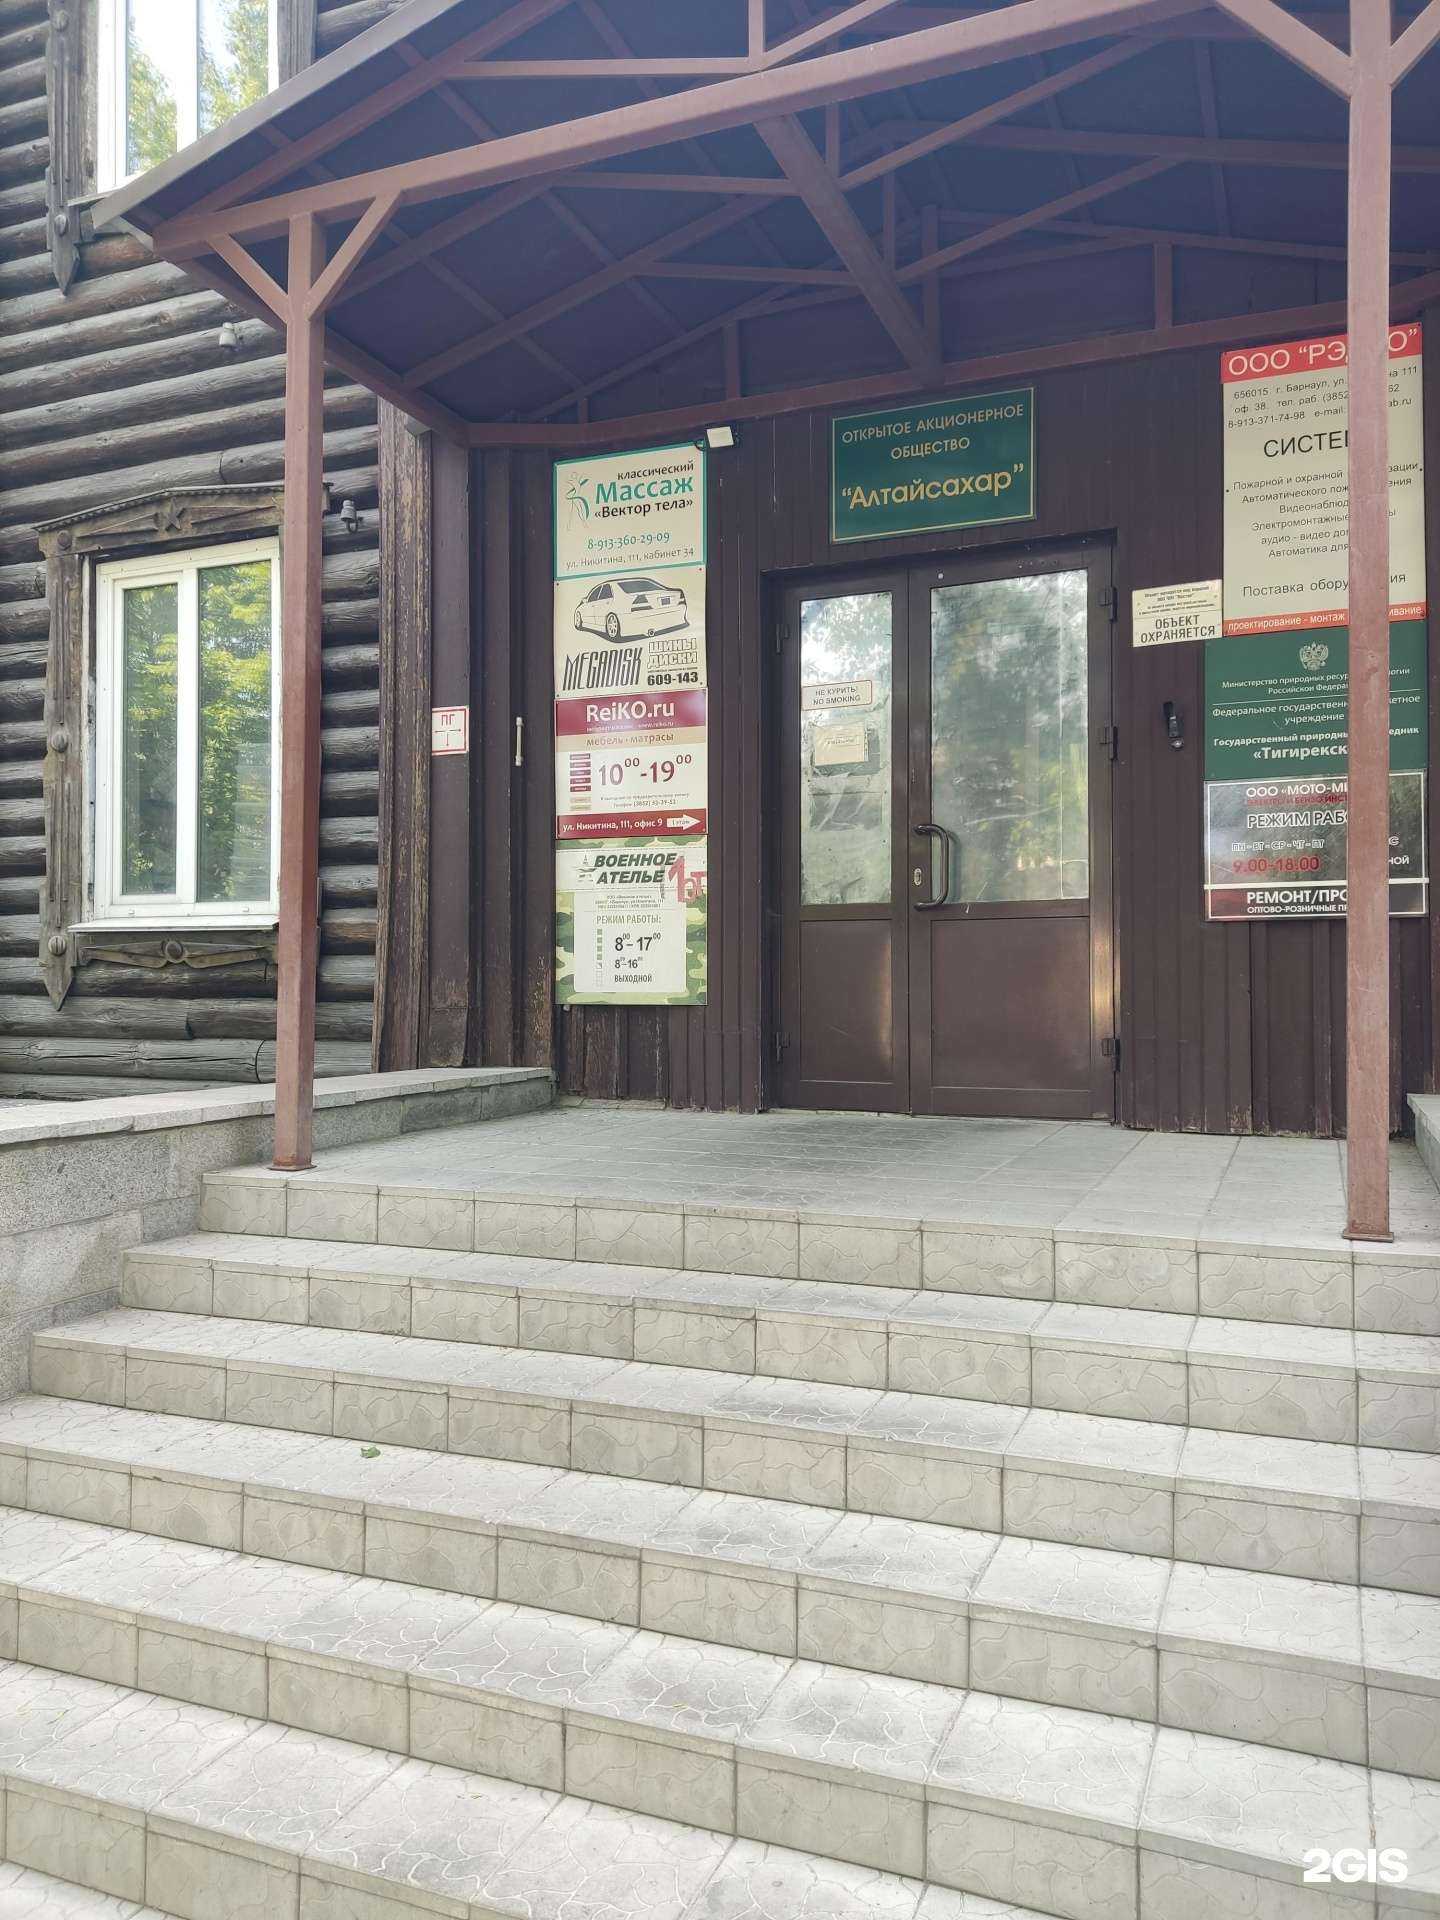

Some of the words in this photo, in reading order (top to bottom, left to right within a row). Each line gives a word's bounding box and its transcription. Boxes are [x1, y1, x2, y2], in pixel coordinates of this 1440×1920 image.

[1229, 349, 1290, 375] ООО
[842, 421, 911, 444] ОТКРЫТОЕ
[916, 404, 1024, 432] АКЦИОНЕРНОЕ
[891, 436, 970, 460] ОБЩЕСТВО
[617, 460, 694, 481] классический
[841, 463, 1024, 510] “Алтайсахар”
[1233, 476, 1284, 490] Пожарной
[1295, 470, 1343, 483] охранной
[595, 476, 693, 504] Массаж
[1242, 488, 1327, 504] Автоматического
[594, 502, 651, 518] «Вектор
[655, 499, 693, 512] тела»
[587, 531, 670, 551] 8-913-360-29-09
[1261, 535, 1291, 545] аудио
[1300, 530, 1330, 541] видео
[1333, 529, 1349, 538] до
[1269, 545, 1328, 558] Автоматика
[1243, 583, 1304, 598] Поставка
[1155, 614, 1200, 629] ОБЪЕКТ
[1228, 617, 1301, 632] проектирование
[1310, 613, 1345, 624] монтаж
[1140, 625, 1215, 644] ОХРАНЯЕТСЯ
[648, 637, 697, 653] ШИНЫ
[647, 651, 697, 669] ДИСКИ
[647, 672, 698, 686] 609-143
[1222, 680, 1278, 689] Министерство
[1280, 676, 1325, 685] природных
[1316, 682, 1348, 691] Федера
[826, 694, 861, 704] SMOKING
[586, 700, 675, 722] ReiKO.ru
[1212, 705, 1277, 717] Федеральное
[1285, 713, 1345, 725] учреждение
[630, 733, 674, 744] матрасы
[1214, 733, 1298, 747] Государственный
[1246, 787, 1278, 797] ООО
[1281, 782, 1348, 795] «МОТО-М
[562, 824, 575, 832] ул.
[576, 820, 618, 830] Никитина,
[634, 819, 655, 829] офис
[657, 818, 663, 826] 9
[1247, 812, 1310, 828] РЕЖИМ
[594, 853, 677, 868] ВОЕННОЕ
[596, 870, 665, 885] АТЕЛЬЕ
[1246, 904, 1337, 914] ОПТОВО-РОЗНИЧНЫЕ
[596, 915, 625, 924] РЕЖИМ
[626, 914, 662, 924] РАБОТЫ:
[614, 974, 652, 984] ВЫХОДНОЙ
